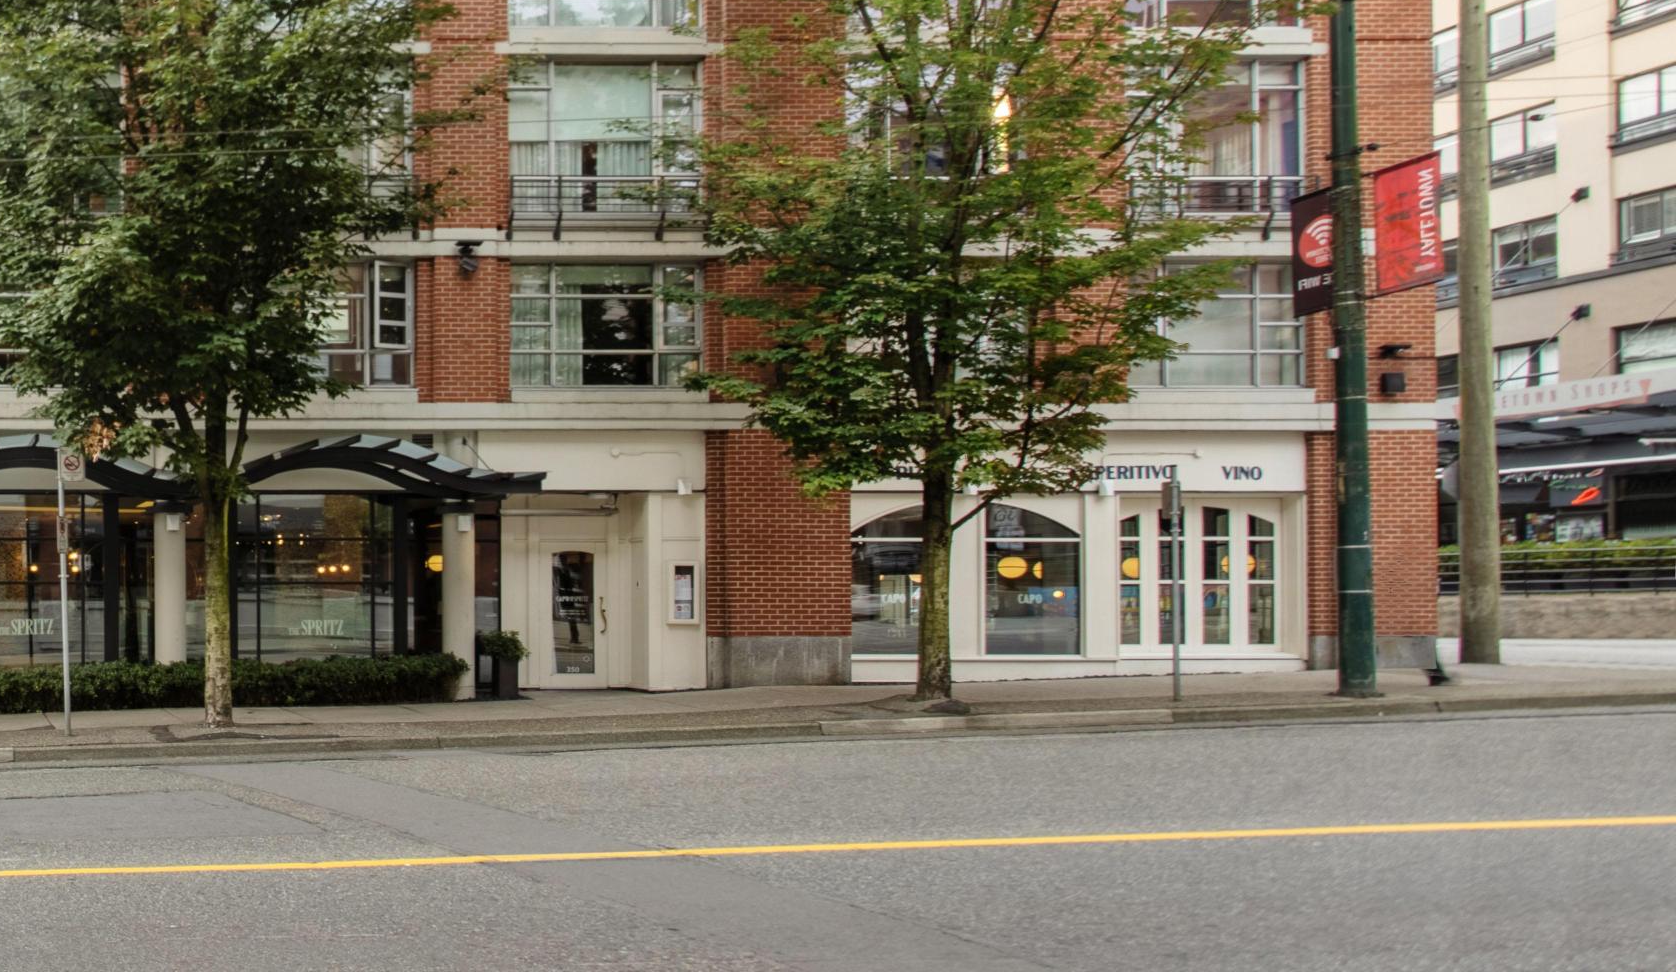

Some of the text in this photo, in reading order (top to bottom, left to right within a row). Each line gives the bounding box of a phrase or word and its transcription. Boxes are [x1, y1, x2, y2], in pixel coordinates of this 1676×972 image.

[1090, 465, 1262, 480] PERITIVO VINO
[881, 593, 906, 604] CAPO
[1017, 593, 1043, 605] CAPO
[10, 618, 54, 635] SPRITZ
[300, 619, 344, 636] SPRITZ
